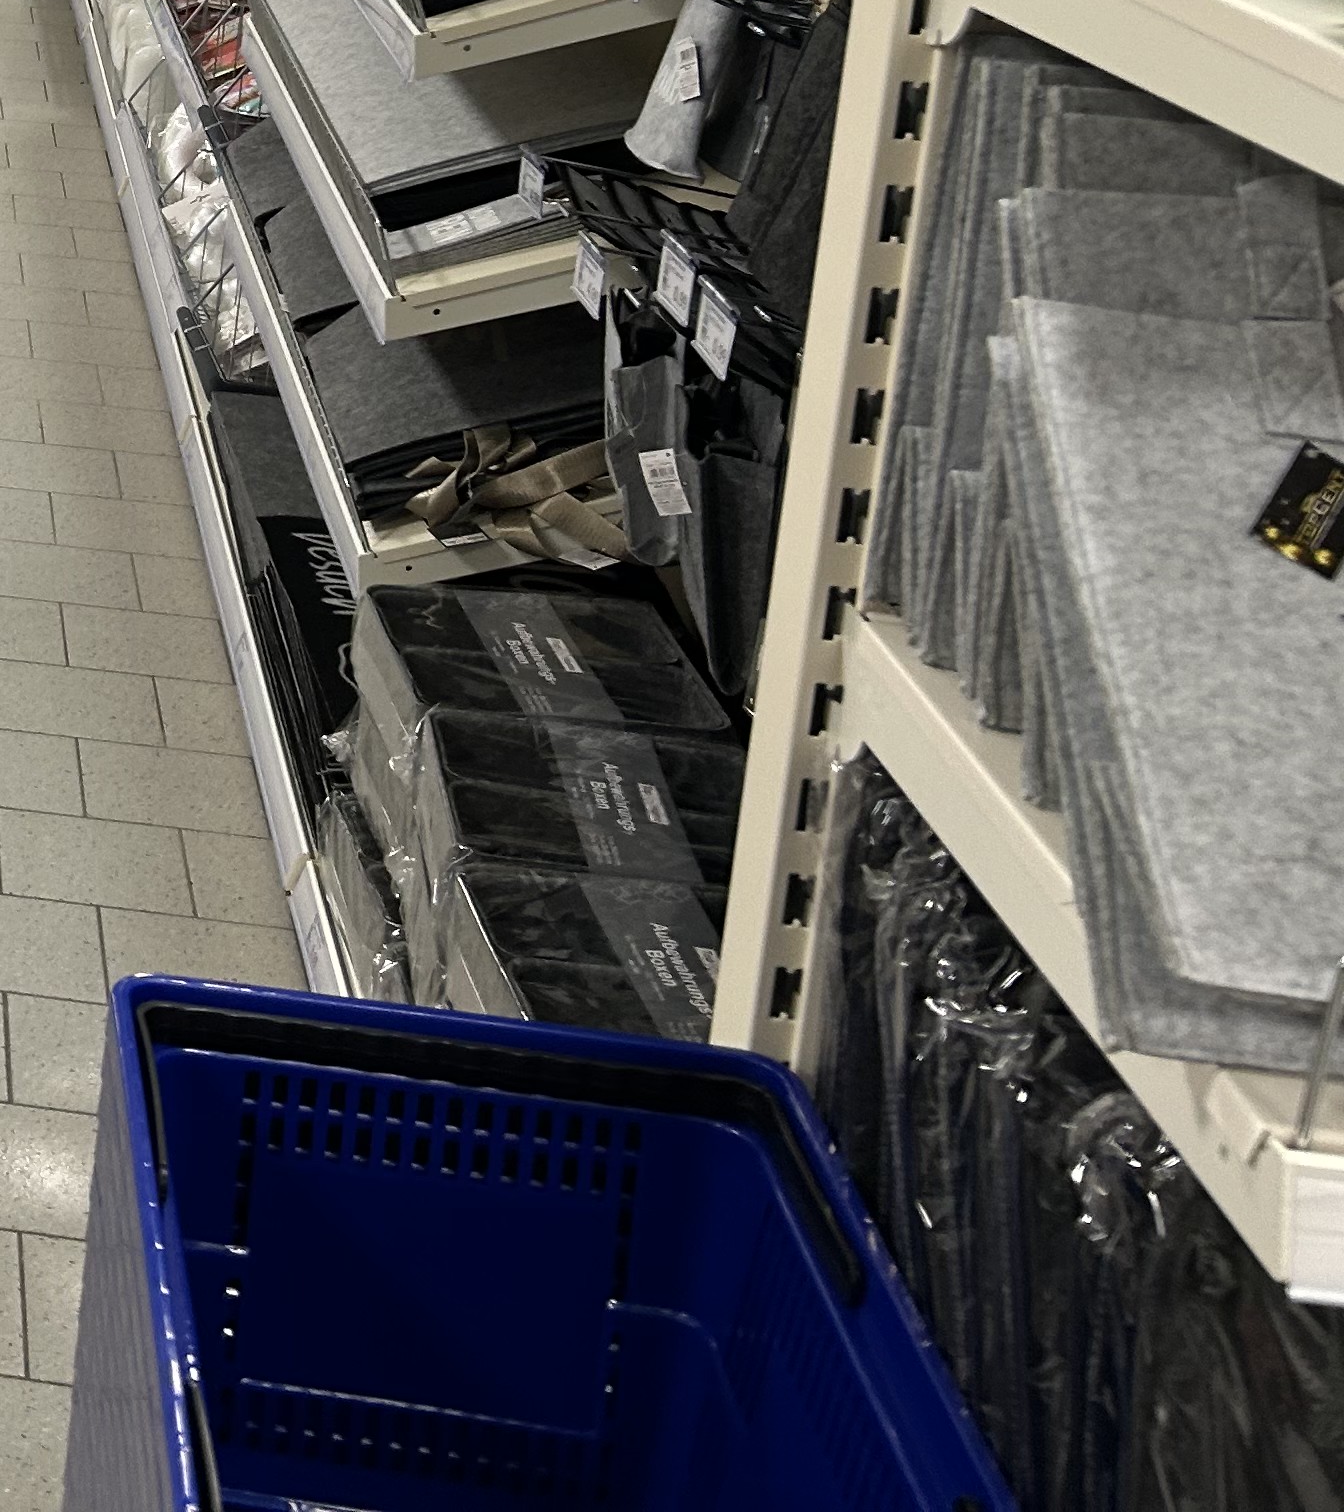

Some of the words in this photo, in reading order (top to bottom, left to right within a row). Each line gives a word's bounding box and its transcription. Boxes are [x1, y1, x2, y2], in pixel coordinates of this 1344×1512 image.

[505, 639, 529, 665] Boxen
[590, 780, 611, 810] Boxen
[644, 947, 677, 988] Boxen
